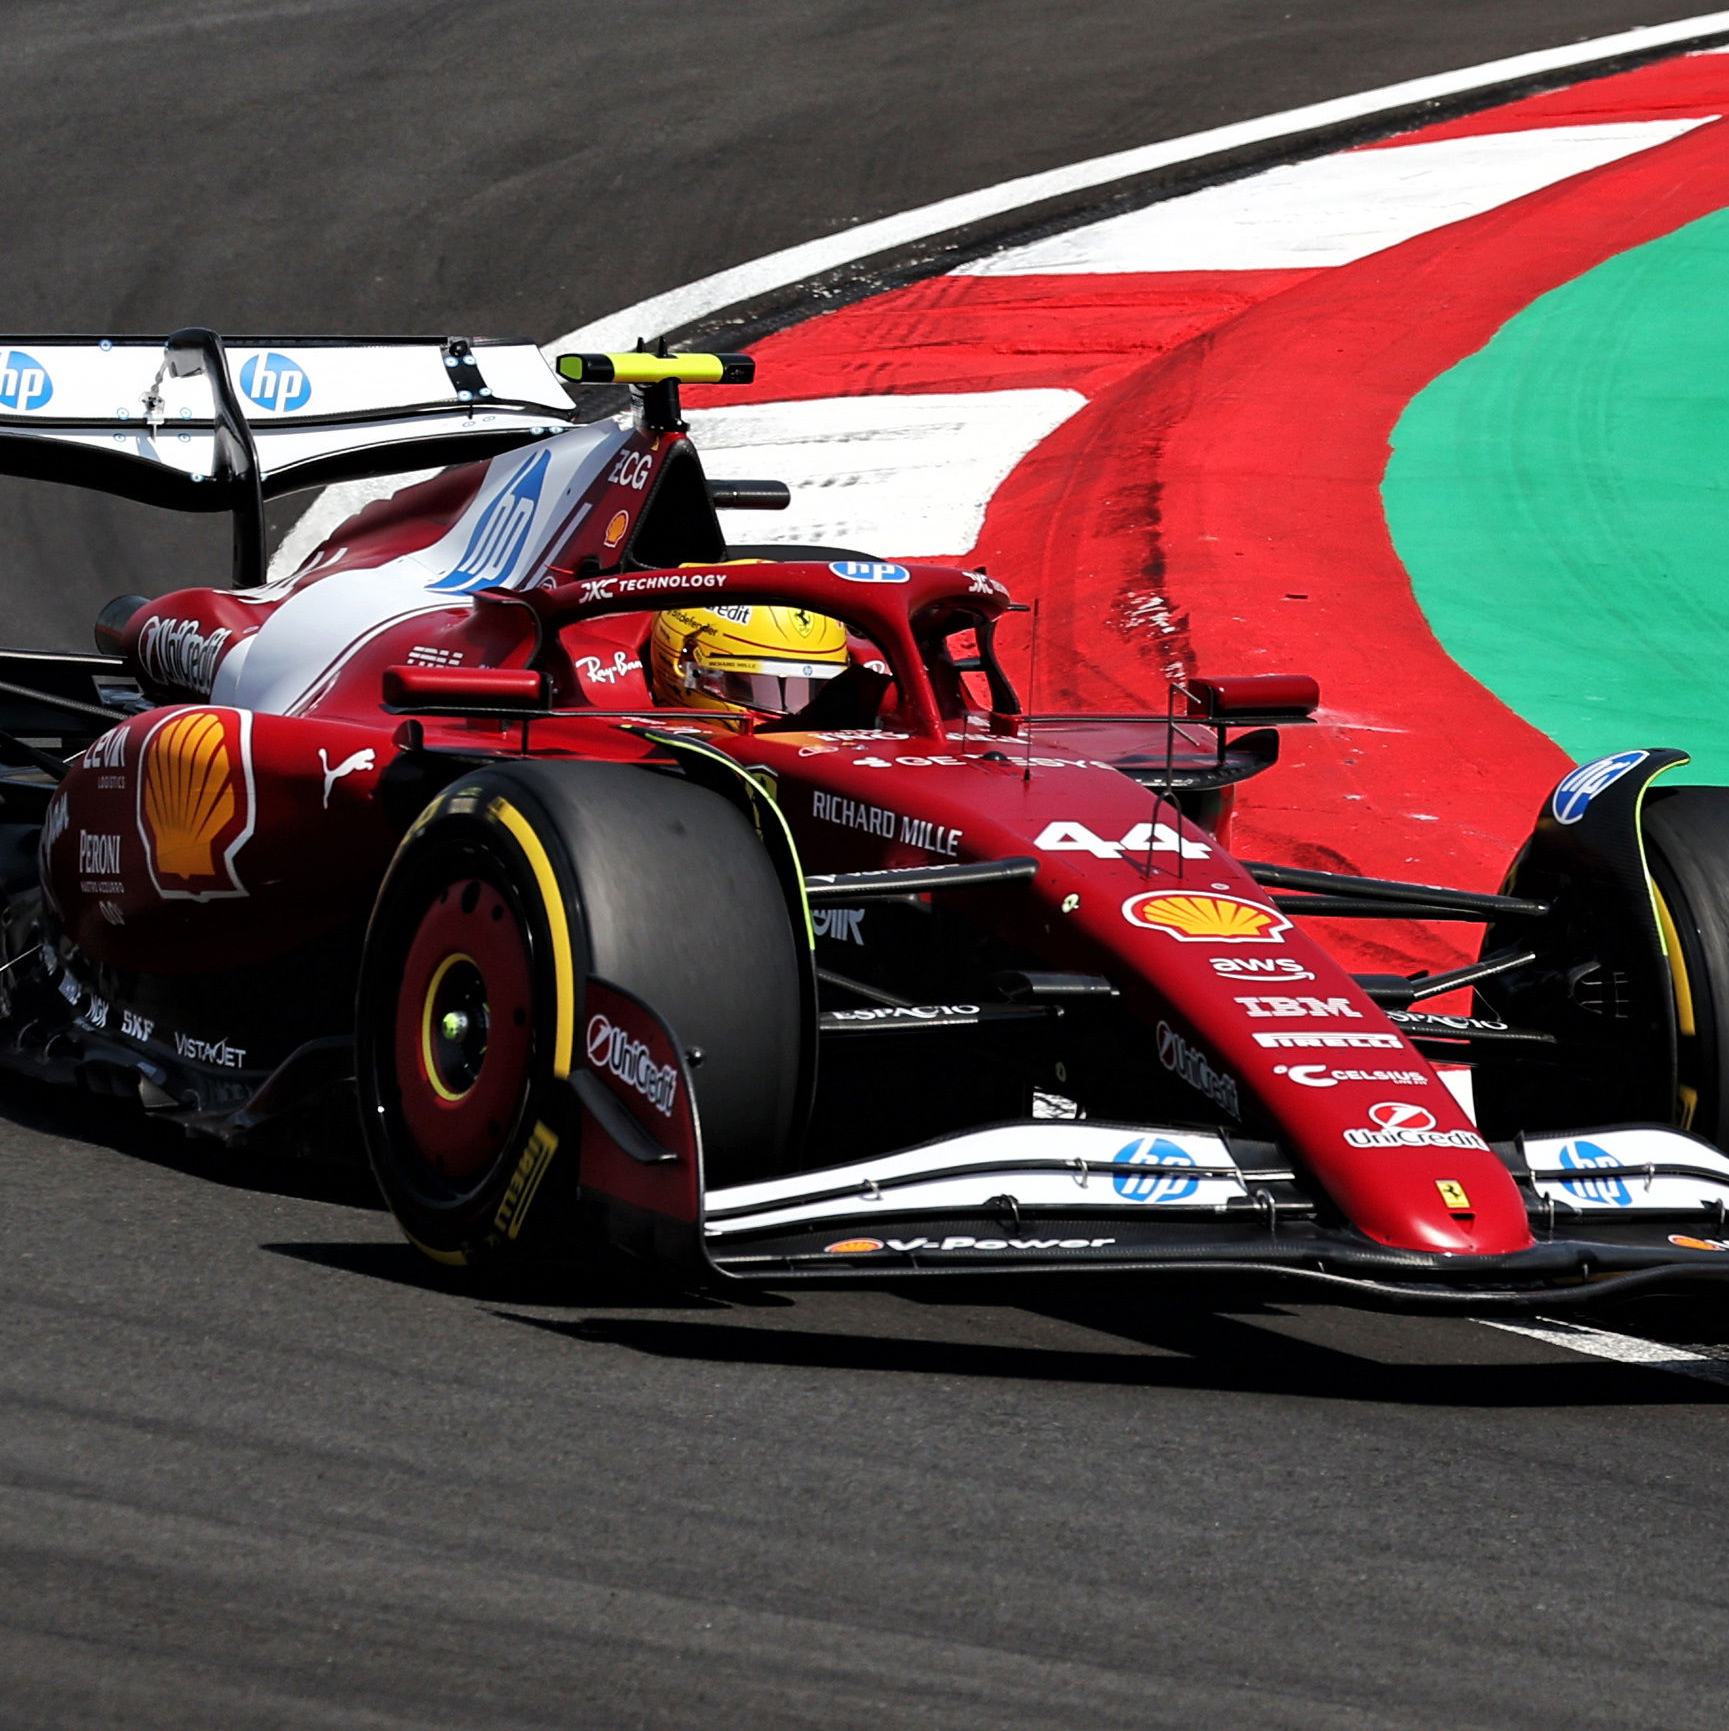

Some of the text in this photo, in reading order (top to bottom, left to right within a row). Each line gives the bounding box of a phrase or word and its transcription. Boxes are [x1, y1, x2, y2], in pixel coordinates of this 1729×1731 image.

[251, 353, 306, 412] hp
[608, 449, 653, 490] ZCG
[619, 574, 727, 593] TECHNOLOGY
[575, 651, 643, 685] Ray-Ban
[812, 790, 964, 858] RICHARD MILLE
[1033, 820, 1214, 860] 44
[78, 829, 121, 874] PERONI
[1209, 957, 1305, 972] aws
[1234, 996, 1364, 1018] IBM
[1385, 1010, 1508, 1030] SPACIO
[120, 1009, 156, 1043] SKF
[1251, 1032, 1405, 1050] PIRELLI
[609, 1027, 678, 1118] UniCredit
[1346, 1128, 1486, 1151] UniCredit
[881, 1234, 1117, 1251] V-Power
